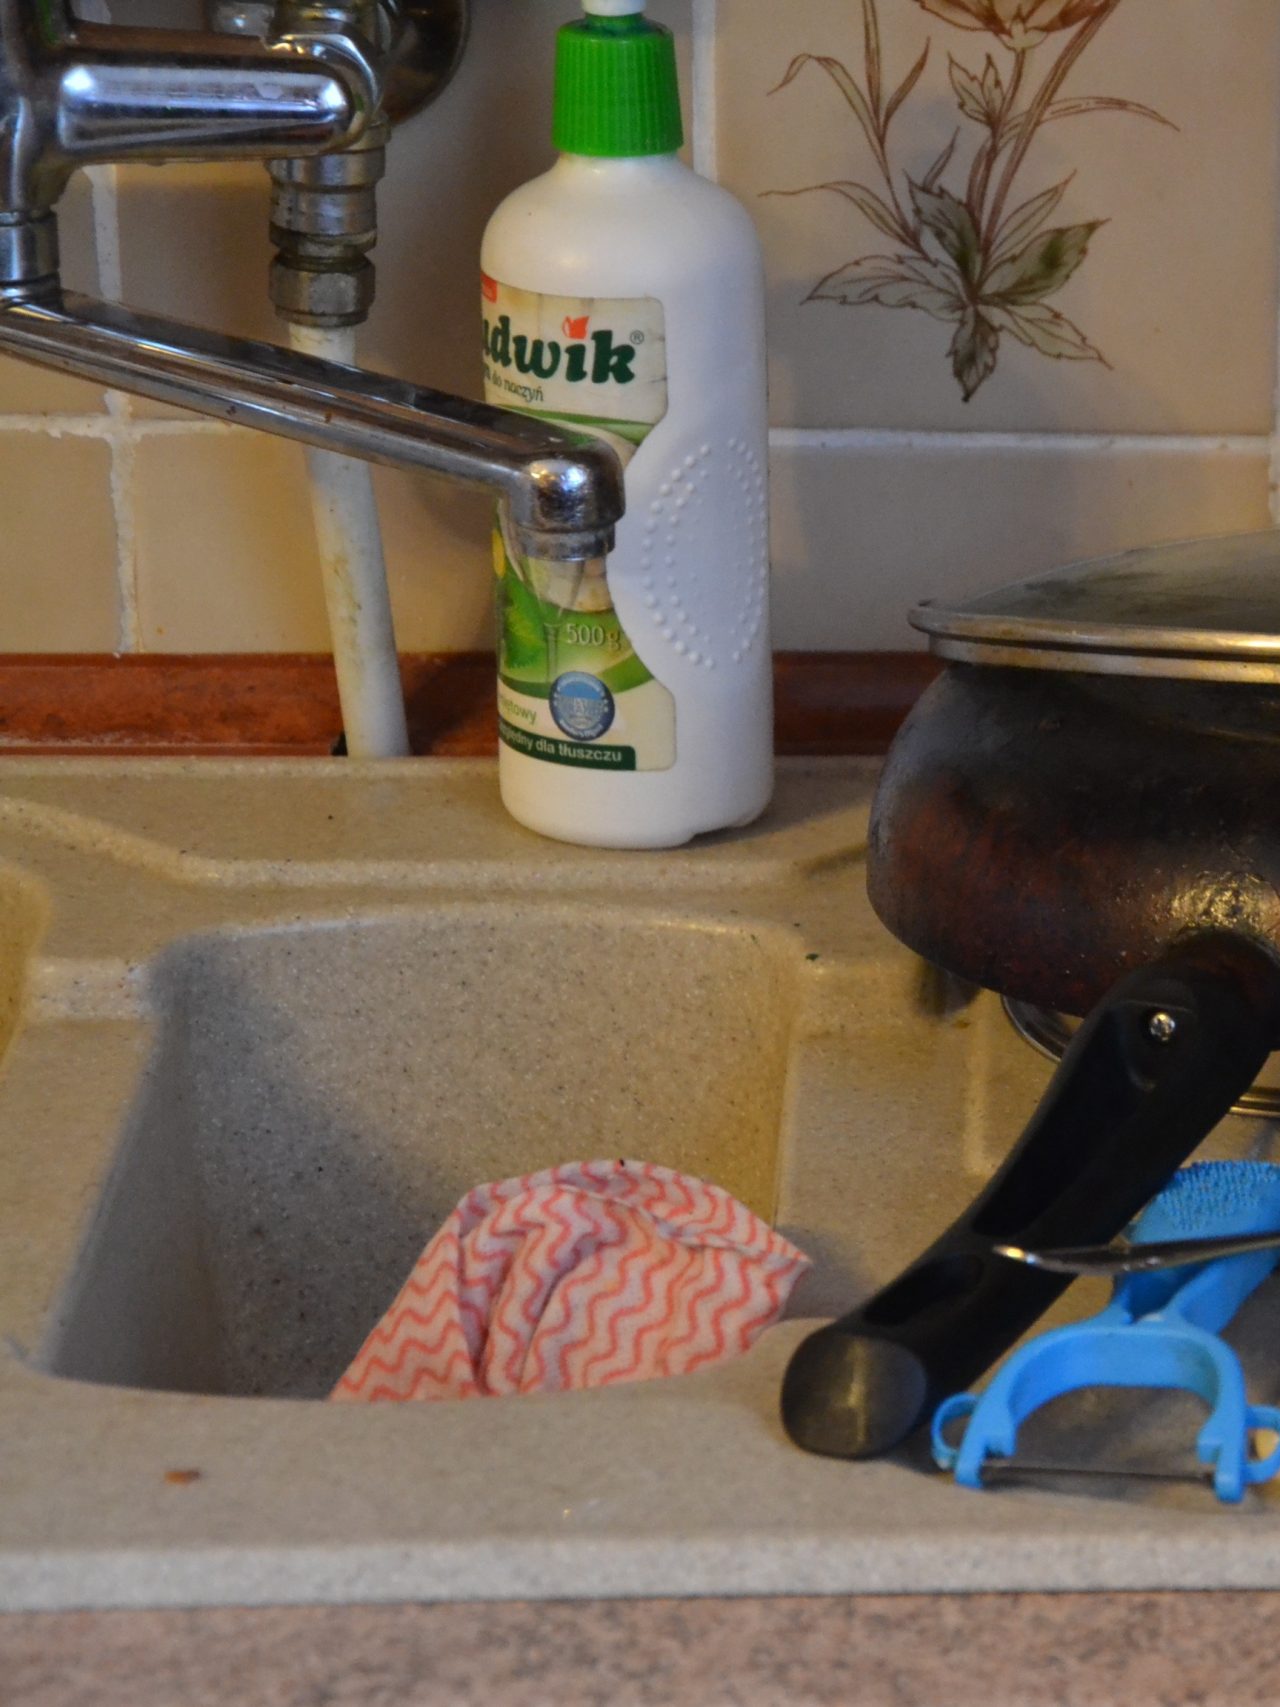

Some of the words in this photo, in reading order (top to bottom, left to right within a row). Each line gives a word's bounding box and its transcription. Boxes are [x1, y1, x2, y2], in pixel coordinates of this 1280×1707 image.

[483, 315, 636, 384] udwik
[504, 379, 544, 402] naczyń
[566, 622, 606, 646] 500
[608, 631, 622, 652] g
[535, 739, 556, 754] dla
[559, 744, 622, 762] tłuszczu
